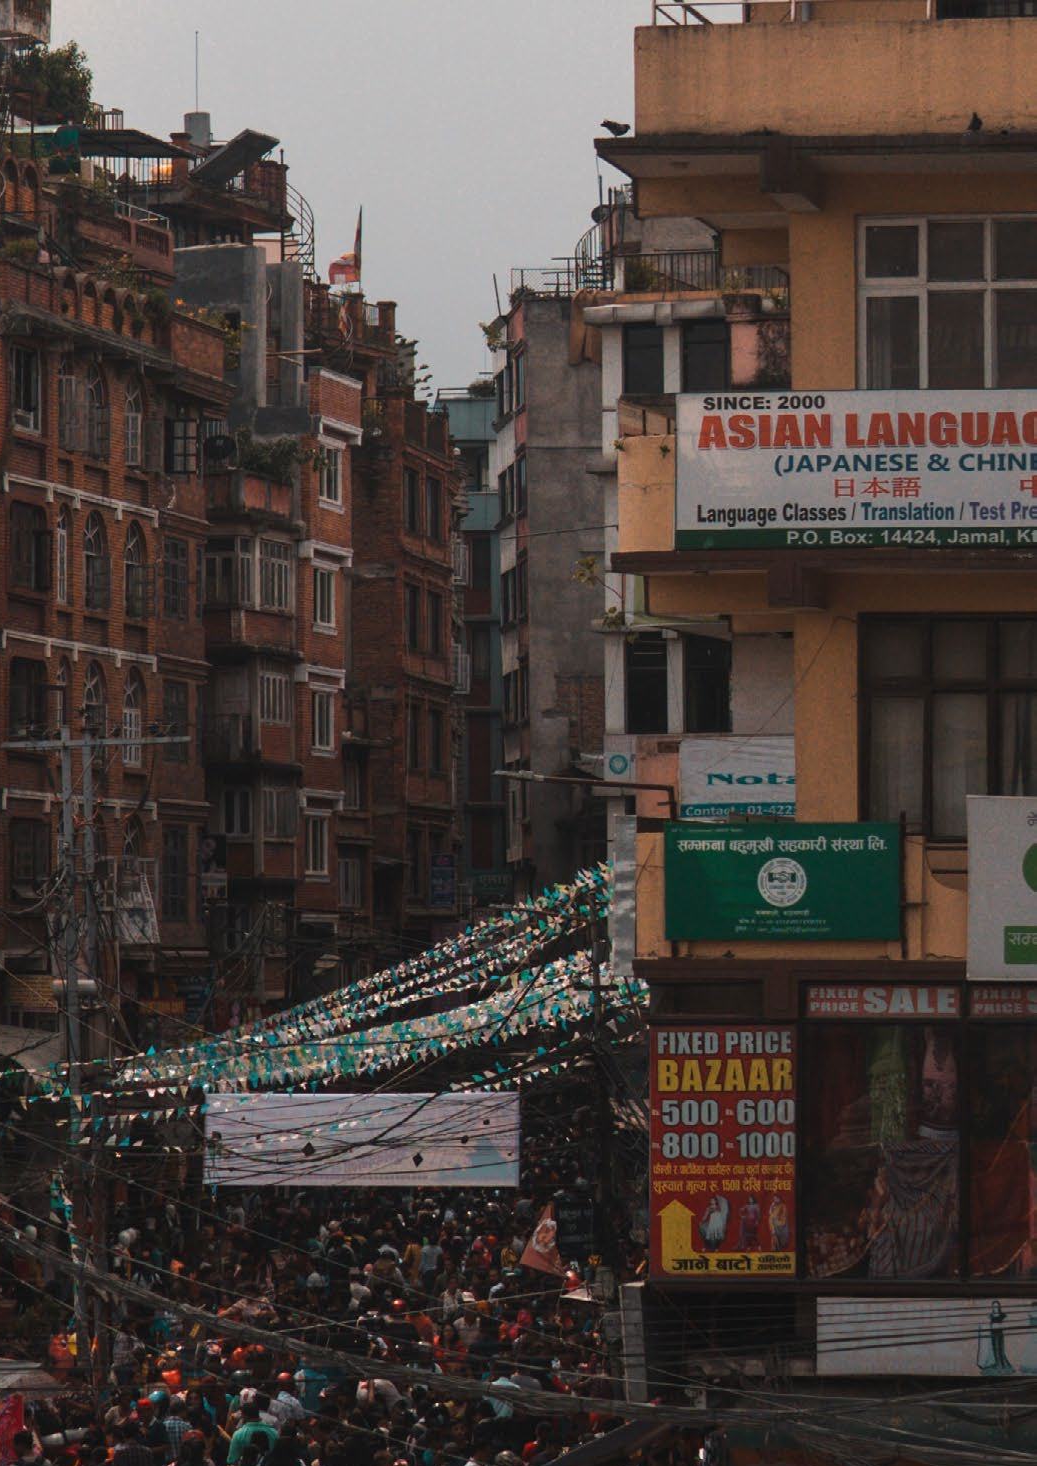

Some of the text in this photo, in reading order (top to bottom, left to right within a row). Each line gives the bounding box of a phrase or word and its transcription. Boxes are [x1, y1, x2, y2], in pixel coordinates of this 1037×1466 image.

[703, 395, 826, 410] SINCE: 2000
[698, 413, 833, 450] ASIAN
[775, 453, 919, 476] (JAPANESE
[927, 454, 950, 472] &
[834, 476, 922, 499] 日本語
[697, 503, 777, 528] Language
[783, 502, 847, 522] Classes
[861, 501, 955, 522] Translation
[969, 501, 1006, 521] Test
[787, 531, 825, 545] P.O.
[830, 531, 874, 545] Box:
[880, 531, 942, 547] 14424,
[947, 530, 1011, 547] Jamal,
[748, 804, 795, 816] 01-422
[810, 986, 957, 1014] FIXED SALE
[810, 1001, 859, 1013] PRICE
[657, 1030, 793, 1054] FIXED PRICE
[657, 1058, 794, 1092] BAZAAR
[736, 1099, 795, 1126] 600
[736, 1130, 795, 1159] 1000
